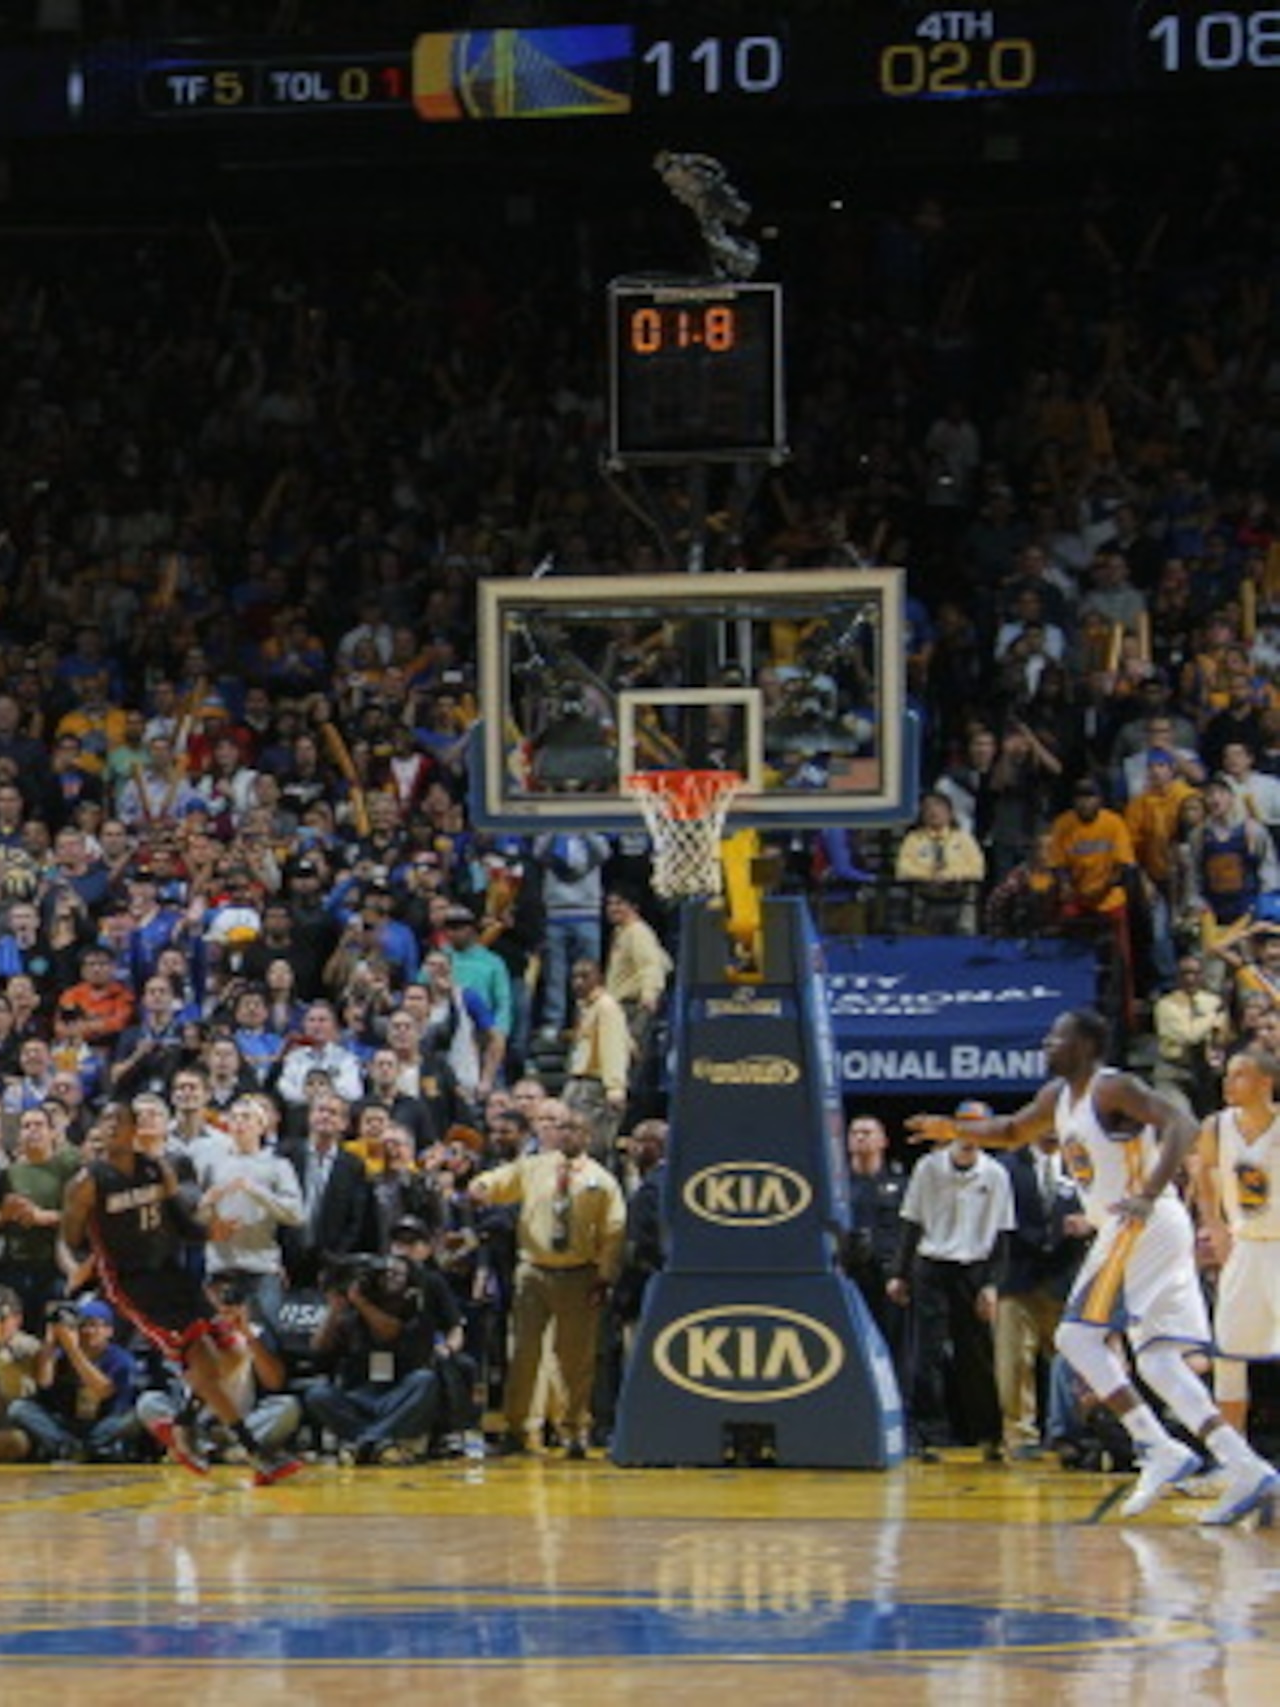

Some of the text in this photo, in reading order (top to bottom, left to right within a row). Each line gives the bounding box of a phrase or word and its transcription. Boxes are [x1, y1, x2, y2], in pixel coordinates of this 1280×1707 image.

[916, 11, 994, 40] 4TH
[1147, 10, 1280, 72] 108
[167, 71, 244, 105] TF 5
[271, 71, 332, 101] TOL
[339, 67, 369, 101] 0
[643, 36, 782, 95] 110
[880, 38, 1035, 95] 02.0
[631, 306, 735, 355] 01.8
[704, 1174, 792, 1214] KIA
[684, 1325, 813, 1380] KIA
